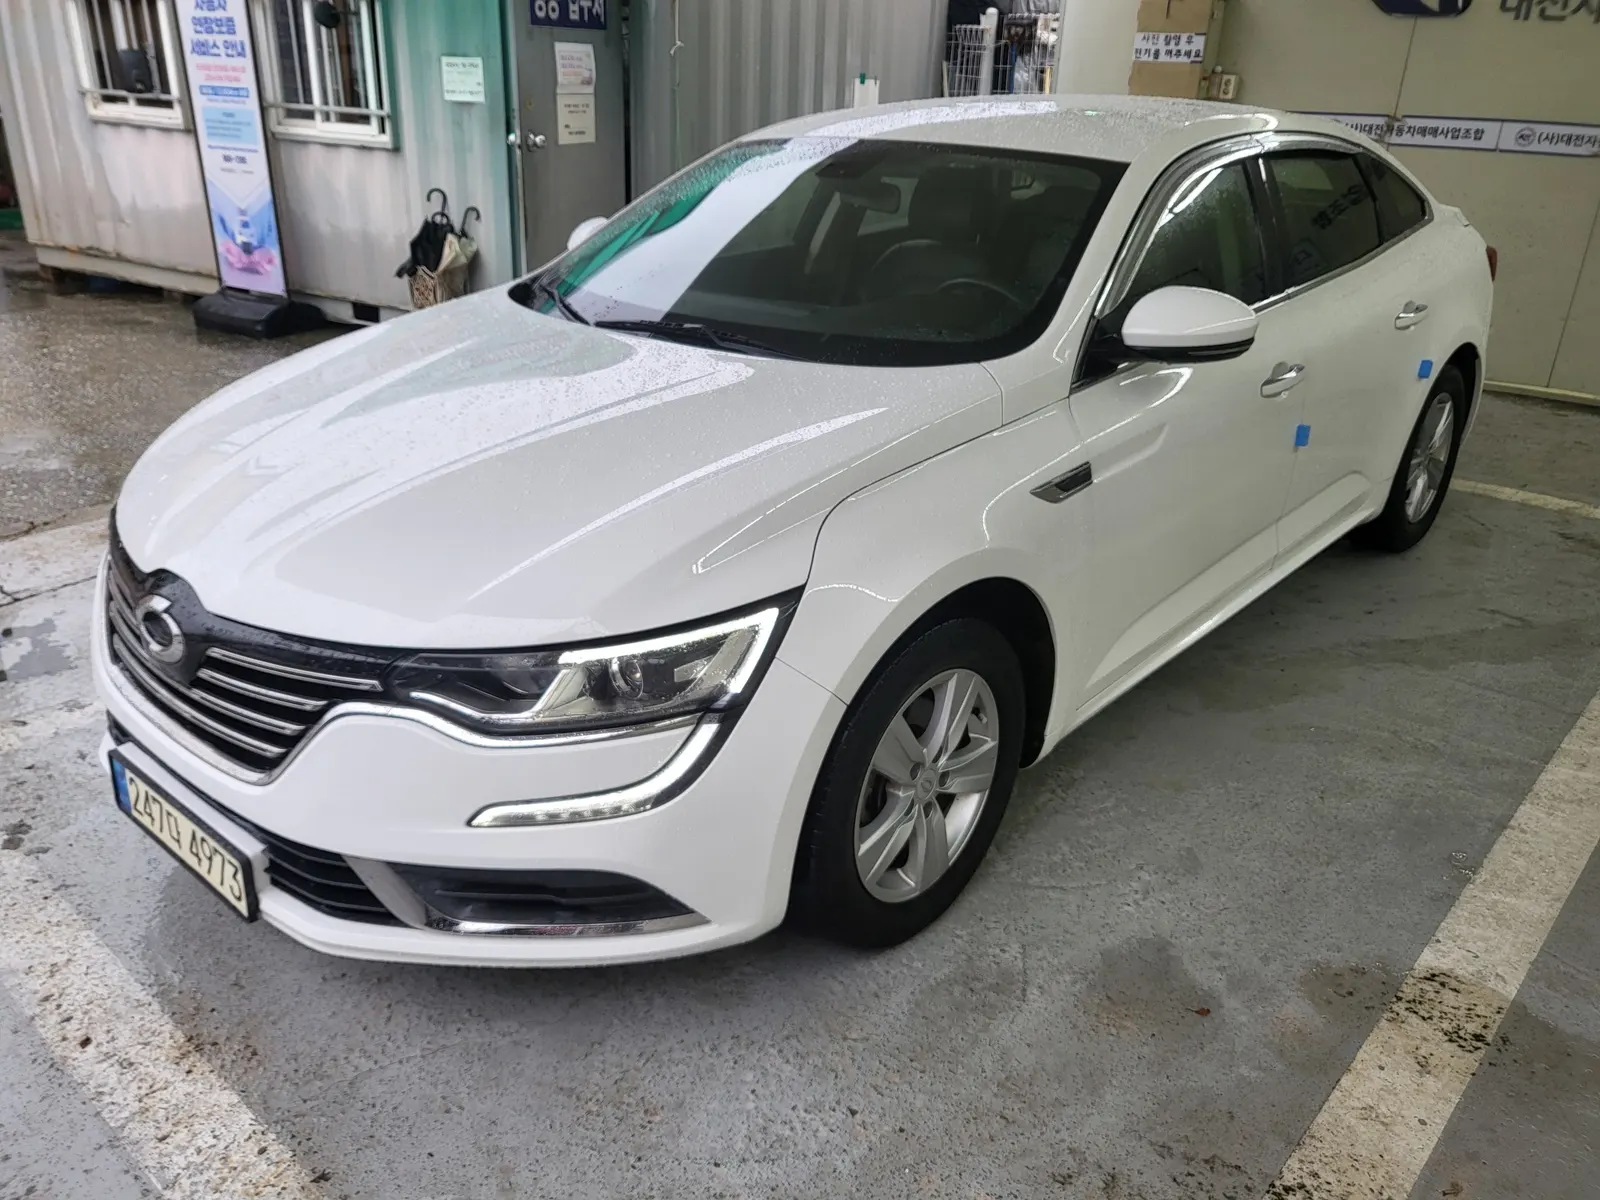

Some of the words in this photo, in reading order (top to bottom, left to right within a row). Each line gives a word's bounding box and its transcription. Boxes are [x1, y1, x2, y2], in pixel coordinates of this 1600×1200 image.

[191, 39, 220, 56] 서비스
[223, 40, 246, 58] 안내
[1141, 34, 1160, 45] 사진
[1537, 131, 1600, 148] (사)대전자
[129, 776, 182, 850] 247마
[189, 828, 242, 902] 4973
